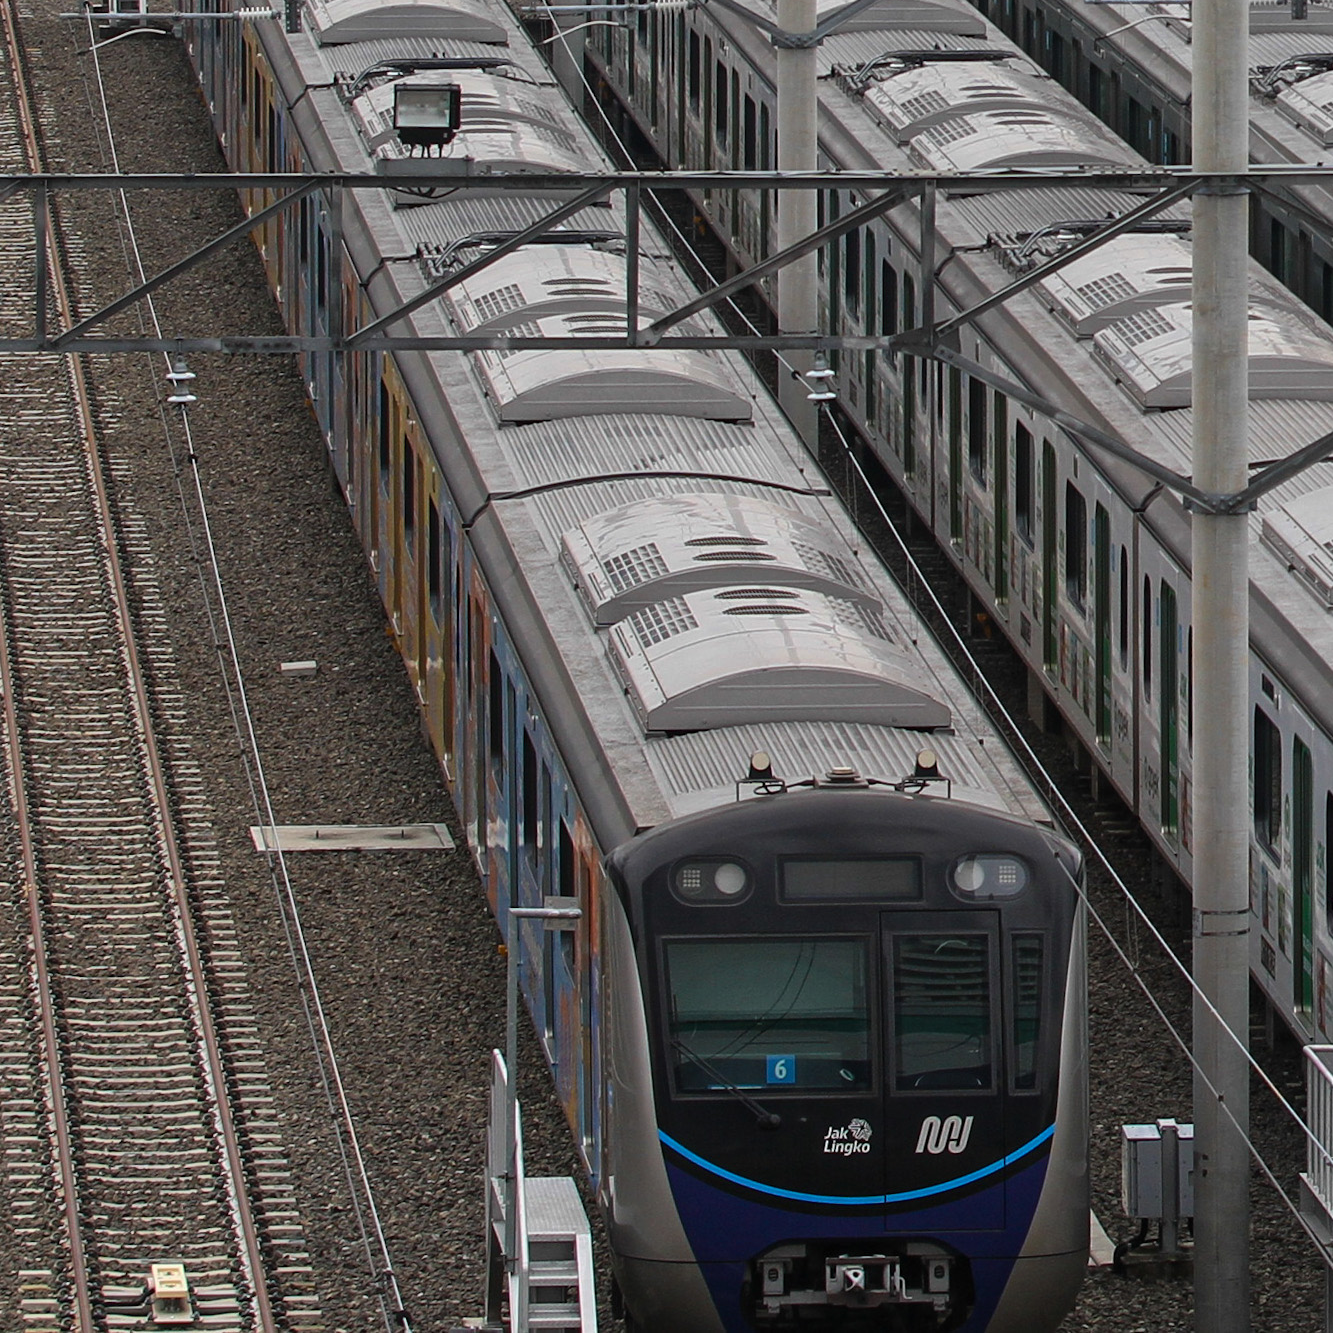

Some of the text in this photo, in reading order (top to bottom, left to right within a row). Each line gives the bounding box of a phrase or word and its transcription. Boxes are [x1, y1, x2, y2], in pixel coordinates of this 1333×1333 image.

[774, 1058, 787, 1079] 6
[824, 1126, 848, 1140] Jak
[823, 1140, 871, 1156] Lingko
